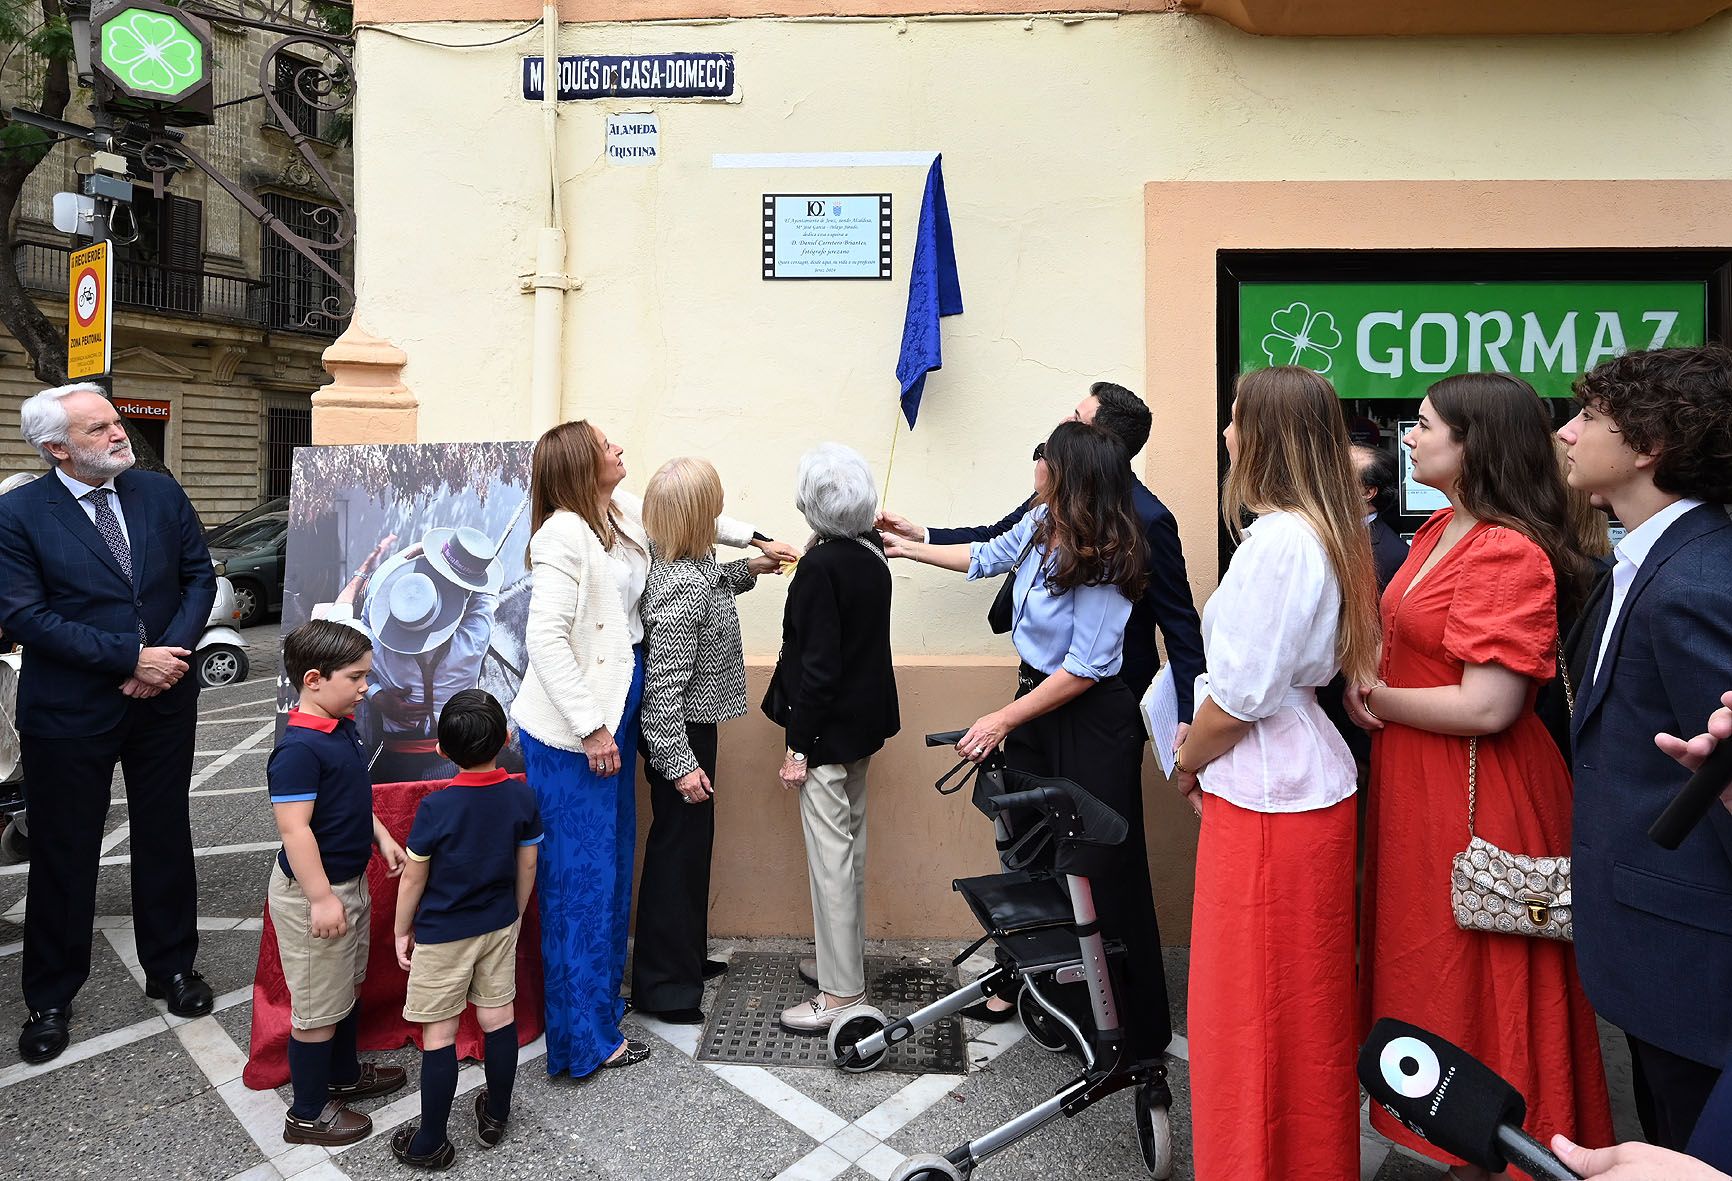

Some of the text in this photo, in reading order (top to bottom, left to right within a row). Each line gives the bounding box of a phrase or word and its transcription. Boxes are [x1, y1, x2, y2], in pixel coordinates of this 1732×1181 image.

[530, 59, 599, 92] MRQUÉS
[621, 59, 727, 90] CASA-DOMECQ
[609, 123, 657, 135] ALAMEDA
[609, 144, 656, 159] CRISTINA
[1356, 310, 1679, 379] GORMAZ
[116, 403, 168, 416] nkinter.
